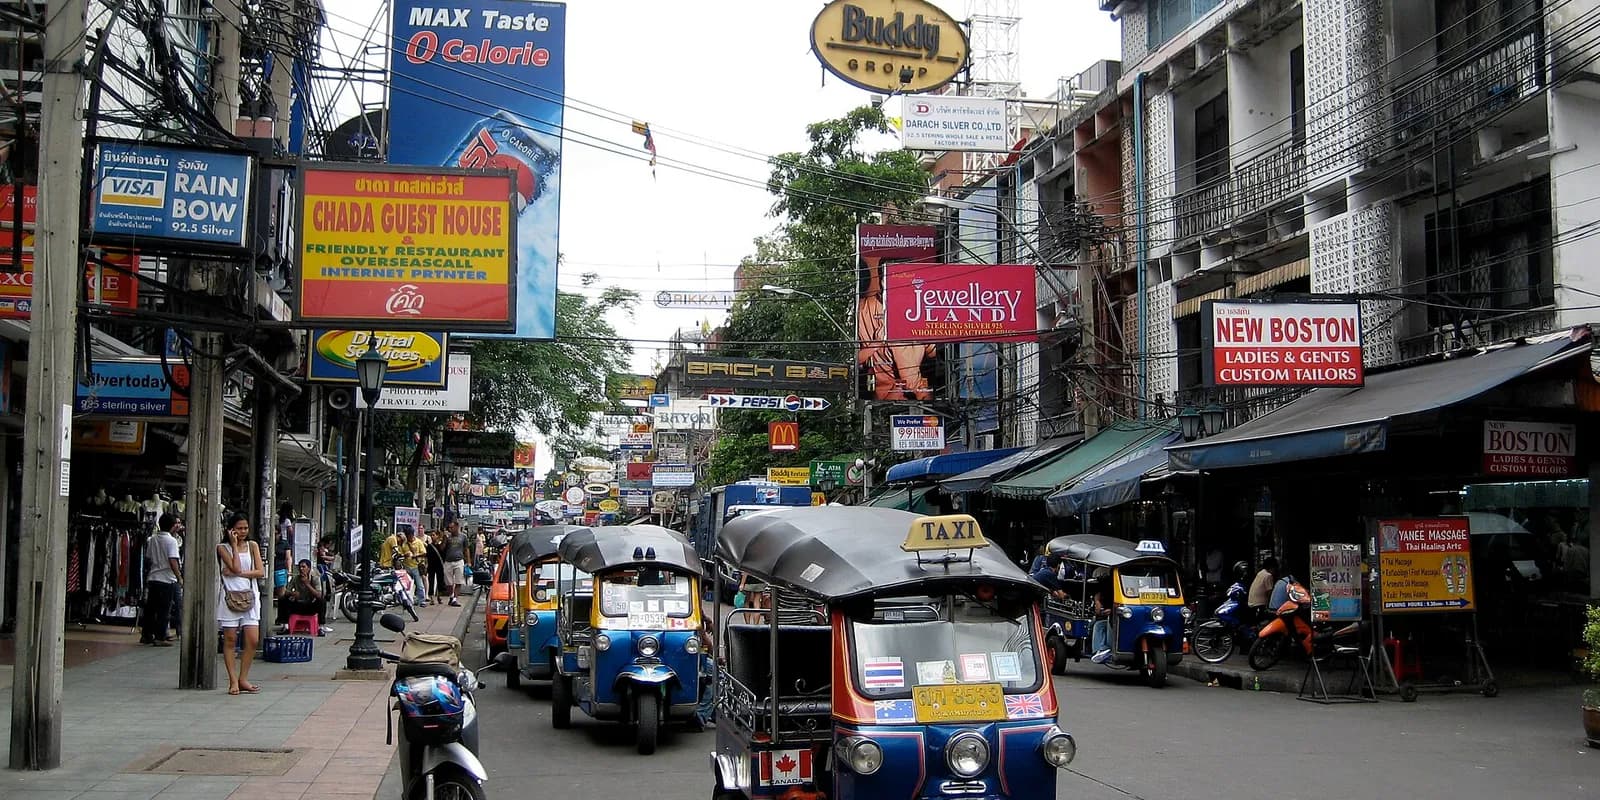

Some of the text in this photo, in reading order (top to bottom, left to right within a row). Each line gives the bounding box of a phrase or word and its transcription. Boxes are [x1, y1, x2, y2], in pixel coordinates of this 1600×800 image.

[409, 8, 550, 32] MAX Taste
[842, 4, 940, 58] Buddy
[442, 39, 550, 67] Calorie
[848, 58, 928, 78] GROP
[906, 119, 939, 129] DARACH
[942, 120, 969, 130] SILVER
[509, 136, 540, 162] CALORIE
[111, 178, 156, 196] VISA
[174, 172, 238, 198] RAIN
[171, 198, 237, 223] BOW
[312, 200, 502, 236] CHADA GUEST HOUSE
[172, 222, 235, 236] 92.5 Silver
[401, 235, 415, 245] &
[306, 243, 505, 258] FRIENDLY RESTAURANT
[340, 256, 473, 269] OVERSEASCALL
[321, 267, 404, 278] INTERNET
[673, 293, 719, 305] RIKKA
[925, 308, 1006, 322] LAND
[911, 329, 958, 337] WHOLESALE
[959, 329, 993, 337] FACTORY
[963, 322, 991, 330] SILVER
[1216, 317, 1356, 343] NEW BOSTON
[352, 331, 414, 349] Digital
[344, 344, 420, 360] Sevices
[1225, 351, 1350, 364] LADIES & GENTS
[448, 366, 469, 375] OUSE
[687, 361, 774, 377] BRICK
[1220, 367, 1357, 382] CUSTOM TAILORS
[102, 401, 137, 412] sterling
[140, 402, 166, 411] silver
[741, 397, 782, 408] PEPSI
[898, 427, 939, 439] 99 FASHION
[1488, 422, 1506, 430] NEW
[1488, 430, 1570, 453] BOSTON
[1493, 455, 1526, 464] LADIES
[1537, 456, 1567, 465] GENTS
[1490, 464, 1568, 474] CUSTOM TAILORS
[921, 520, 976, 541] TAXI
[1398, 529, 1467, 541] YANEE MASSAGE
[1405, 543, 1420, 551] Thai
[1420, 543, 1446, 551] Healing
[1312, 551, 1360, 567] Motor bike
[1322, 568, 1350, 583] Taxi
